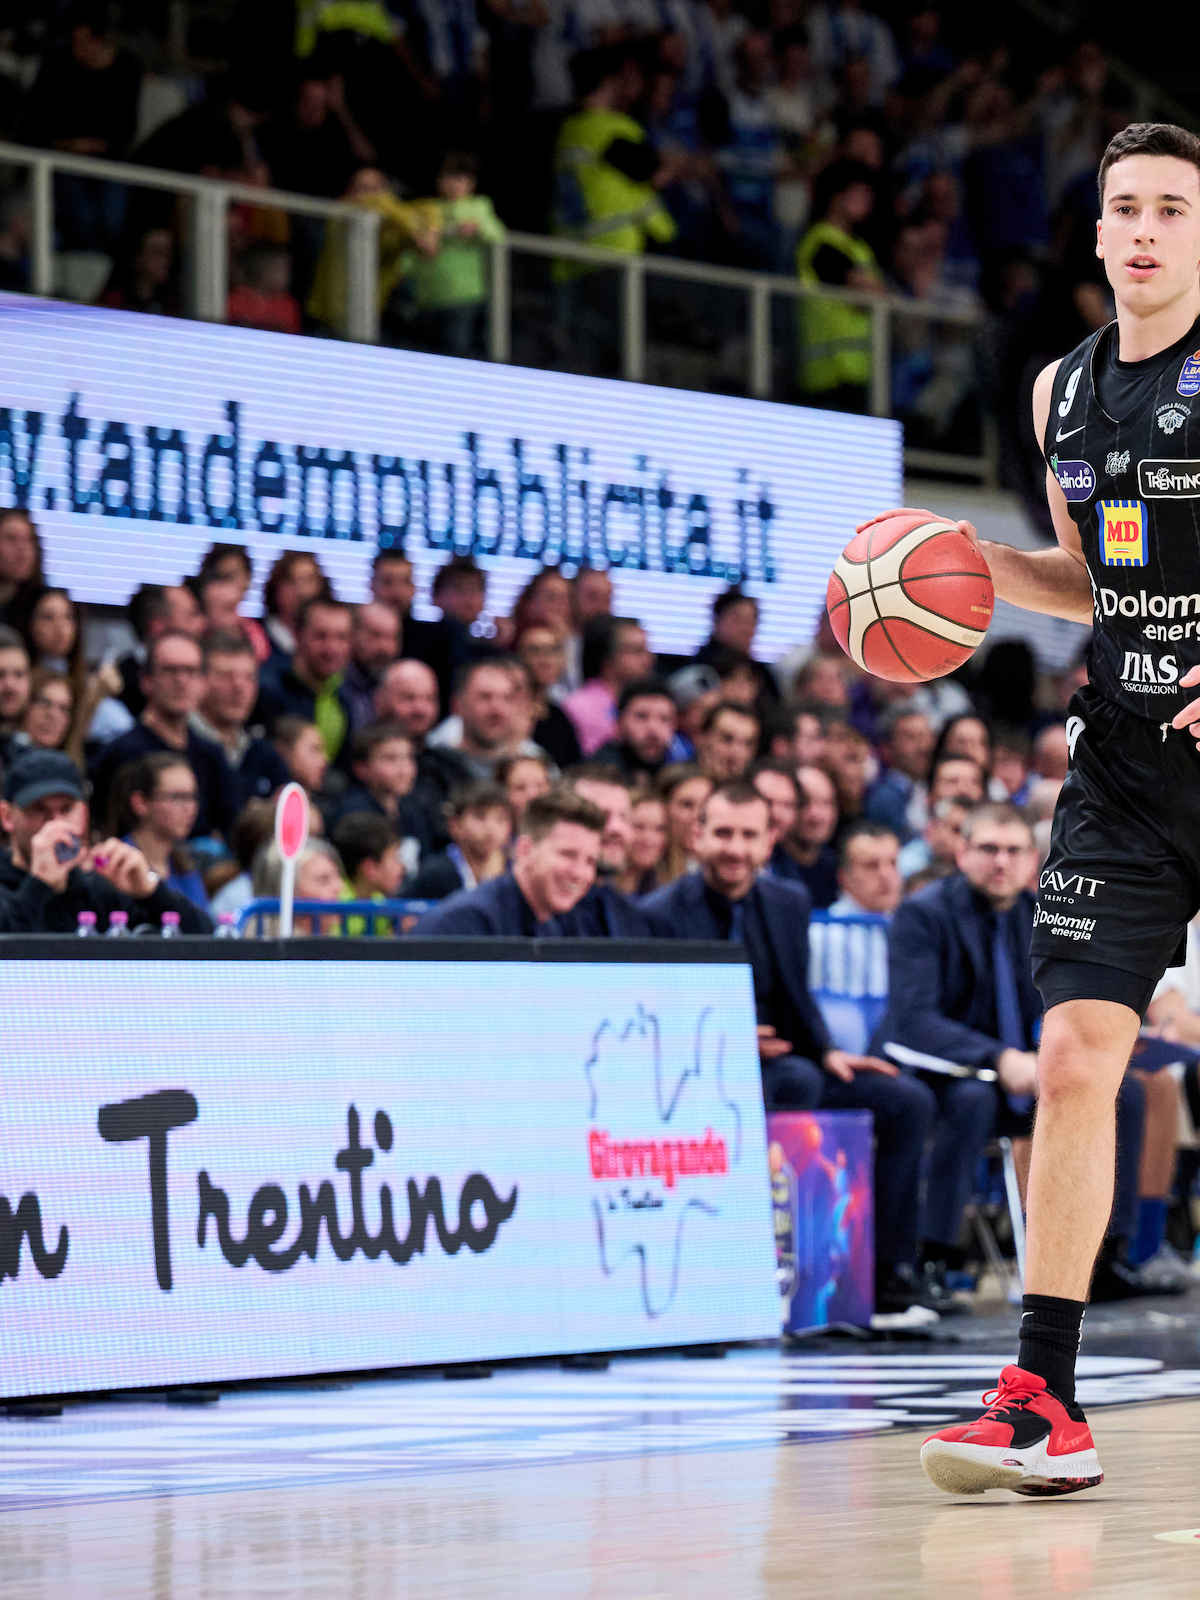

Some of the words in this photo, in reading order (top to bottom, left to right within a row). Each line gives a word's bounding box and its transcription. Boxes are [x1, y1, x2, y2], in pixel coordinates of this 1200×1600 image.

[1058, 366, 1083, 417] 9
[1107, 520, 1139, 542] MD
[1040, 870, 1106, 897] CAVIT
[1044, 894, 1075, 905] TRENTO
[1040, 910, 1096, 932] Dolomiti
[1051, 927, 1092, 941] energia
[98, 1089, 517, 1292] Trentino
